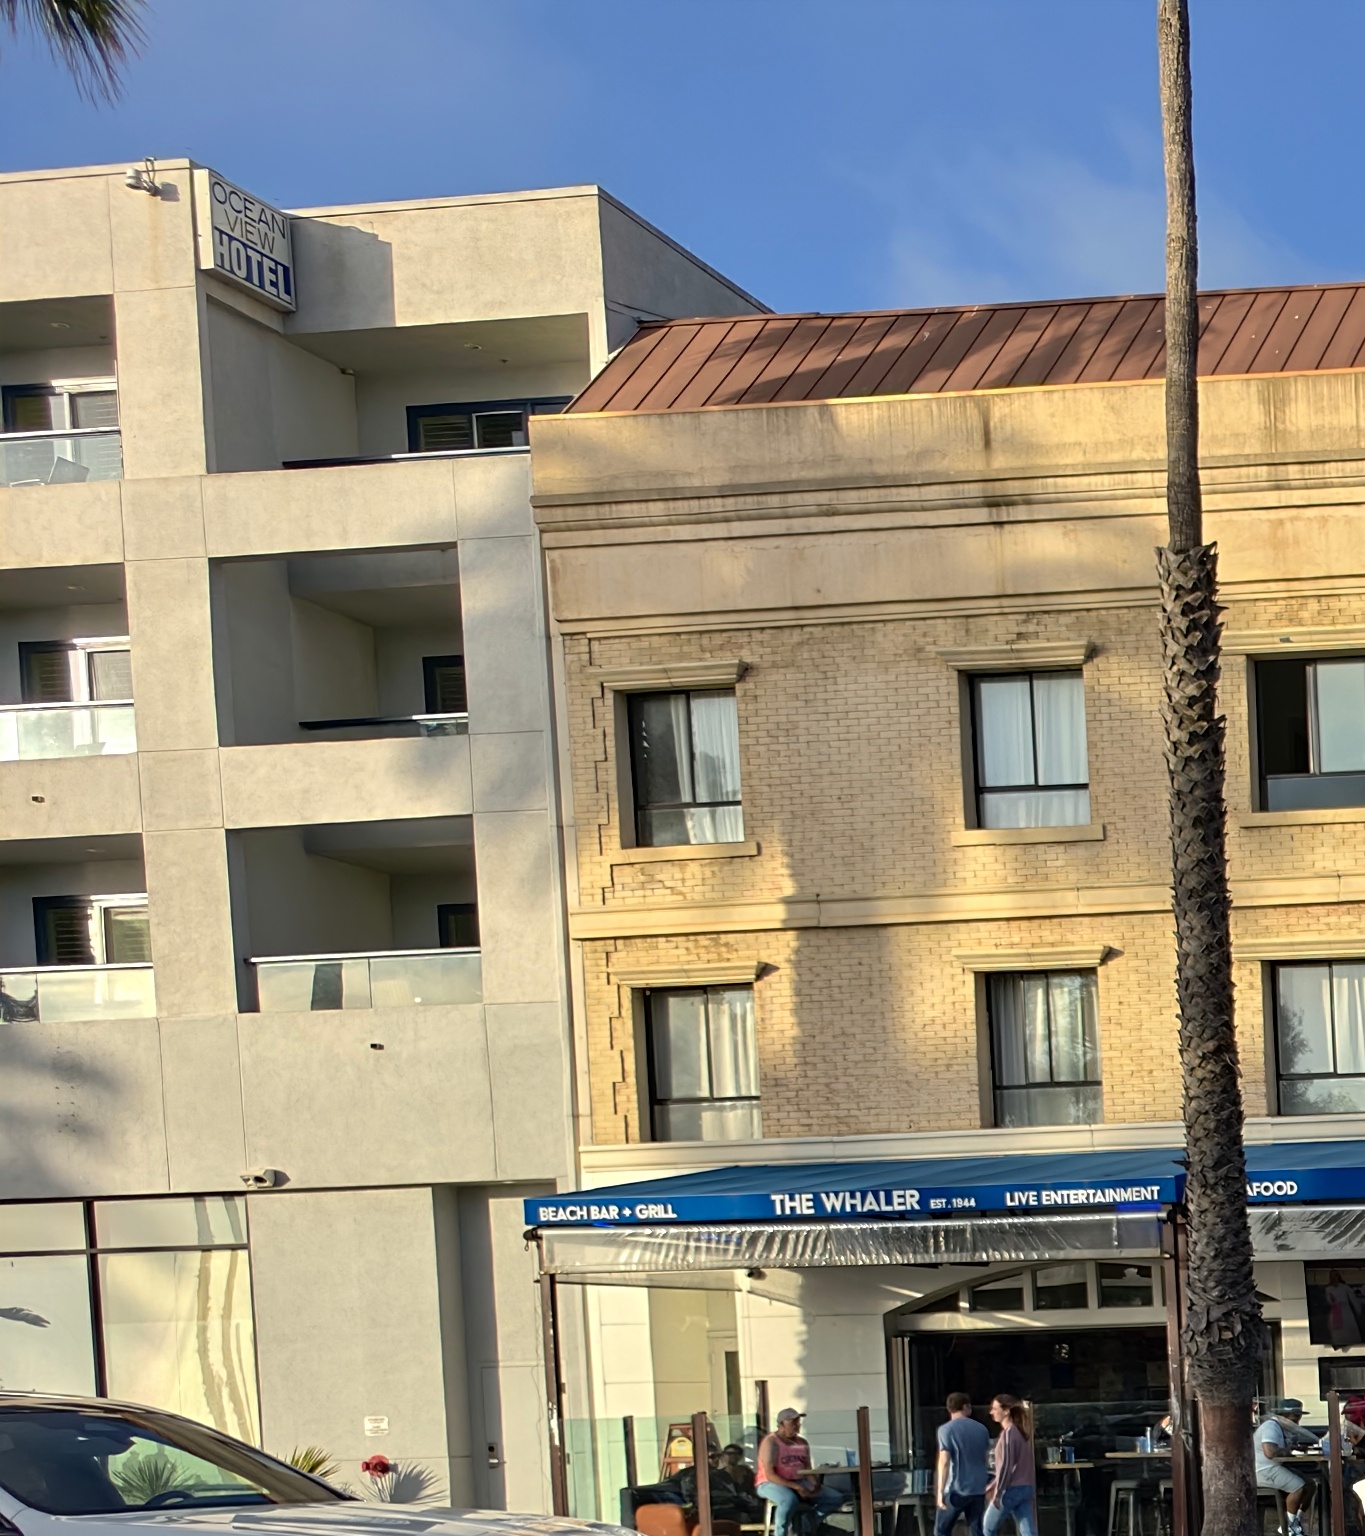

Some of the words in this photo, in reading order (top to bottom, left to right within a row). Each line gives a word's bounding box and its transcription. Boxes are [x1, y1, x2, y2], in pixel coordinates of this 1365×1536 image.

[212, 181, 286, 240] OCEAN
[224, 208, 276, 254] VIEW
[214, 231, 292, 301] HOTEL
[539, 1206, 588, 1221] BEACH
[590, 1205, 619, 1220] BAR
[635, 1204, 677, 1219] GRILL
[771, 1194, 816, 1216] THE
[821, 1190, 921, 1213] WHALER
[1006, 1191, 1039, 1206] LIVE
[1042, 1186, 1160, 1205] ENTERTAINMENT
